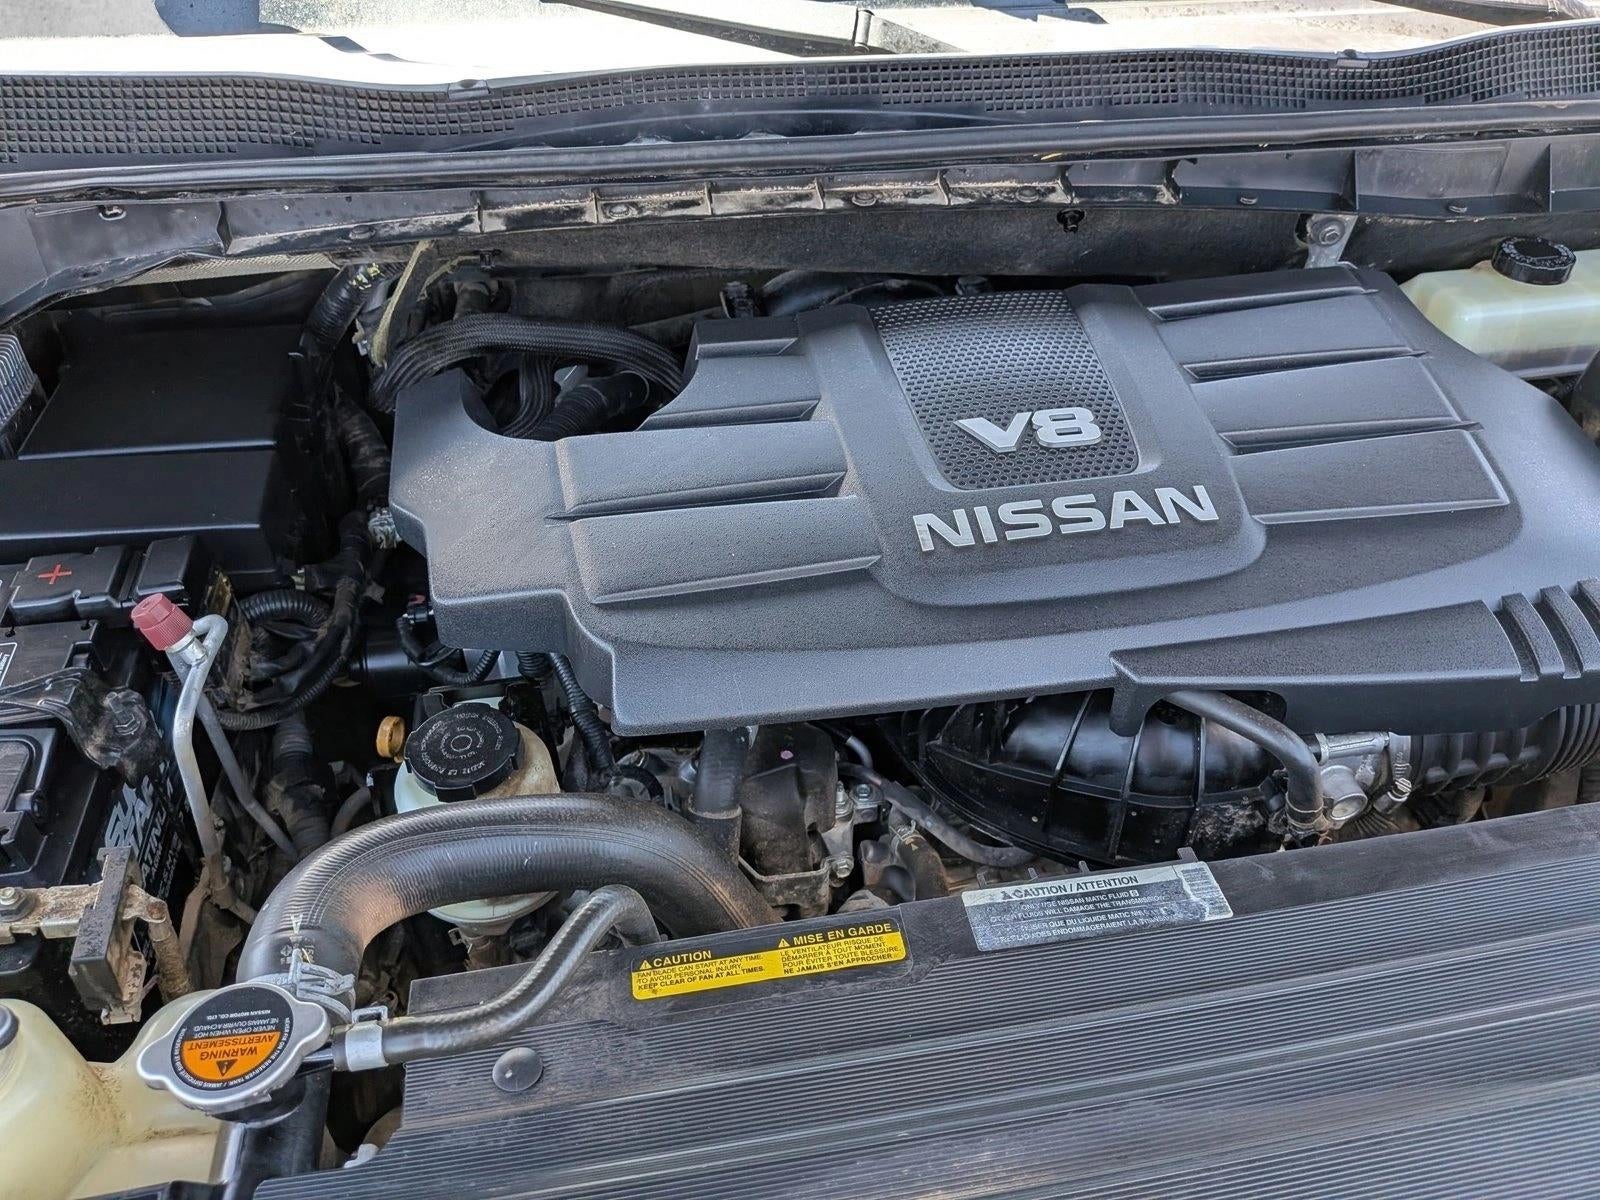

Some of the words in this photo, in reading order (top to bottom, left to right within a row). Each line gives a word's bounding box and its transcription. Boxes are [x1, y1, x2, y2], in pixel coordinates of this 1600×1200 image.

[954, 407, 1100, 453] V8
[913, 485, 1219, 551] NISSAN
[1012, 885, 1067, 899] CAUTION
[1076, 875, 1139, 891] ATTENTION
[1058, 897, 1084, 907] NISSAN
[1085, 894, 1107, 903] MATIC
[1108, 891, 1129, 900] FLUID
[1044, 908, 1062, 916] WILL
[1063, 904, 1095, 913] DAMAGE
[1078, 914, 1106, 924] LIQUIDE
[1107, 911, 1130, 919] MATIC
[793, 934, 824, 945] MISE
[827, 930, 844, 939] EN
[848, 923, 892, 936] GARDE
[791, 942, 842, 954] VENTILATEUR
[844, 938, 875, 946] RISQUE
[833, 946, 853, 954] TOUT
[653, 950, 712, 968] CAUTION
[782, 960, 804, 968] POUR
[834, 951, 859, 961] TOUTE
[796, 963, 825, 973] JAMAIS
[827, 960, 844, 968] S'EN
[637, 971, 652, 979] FAN
[652, 967, 679, 976] BLADE
[679, 964, 694, 972] CAN
[695, 961, 719, 970] START
[719, 959, 728, 967] AT
[729, 958, 743, 966] ANY
[674, 969, 714, 979] PERSONAL
[638, 983, 658, 991] KEEP
[660, 979, 685, 988] CLEAR
[699, 973, 714, 981] FAN
[188, 1034, 275, 1050] AVERTISSEMENT
[200, 1046, 257, 1061] WARNING
